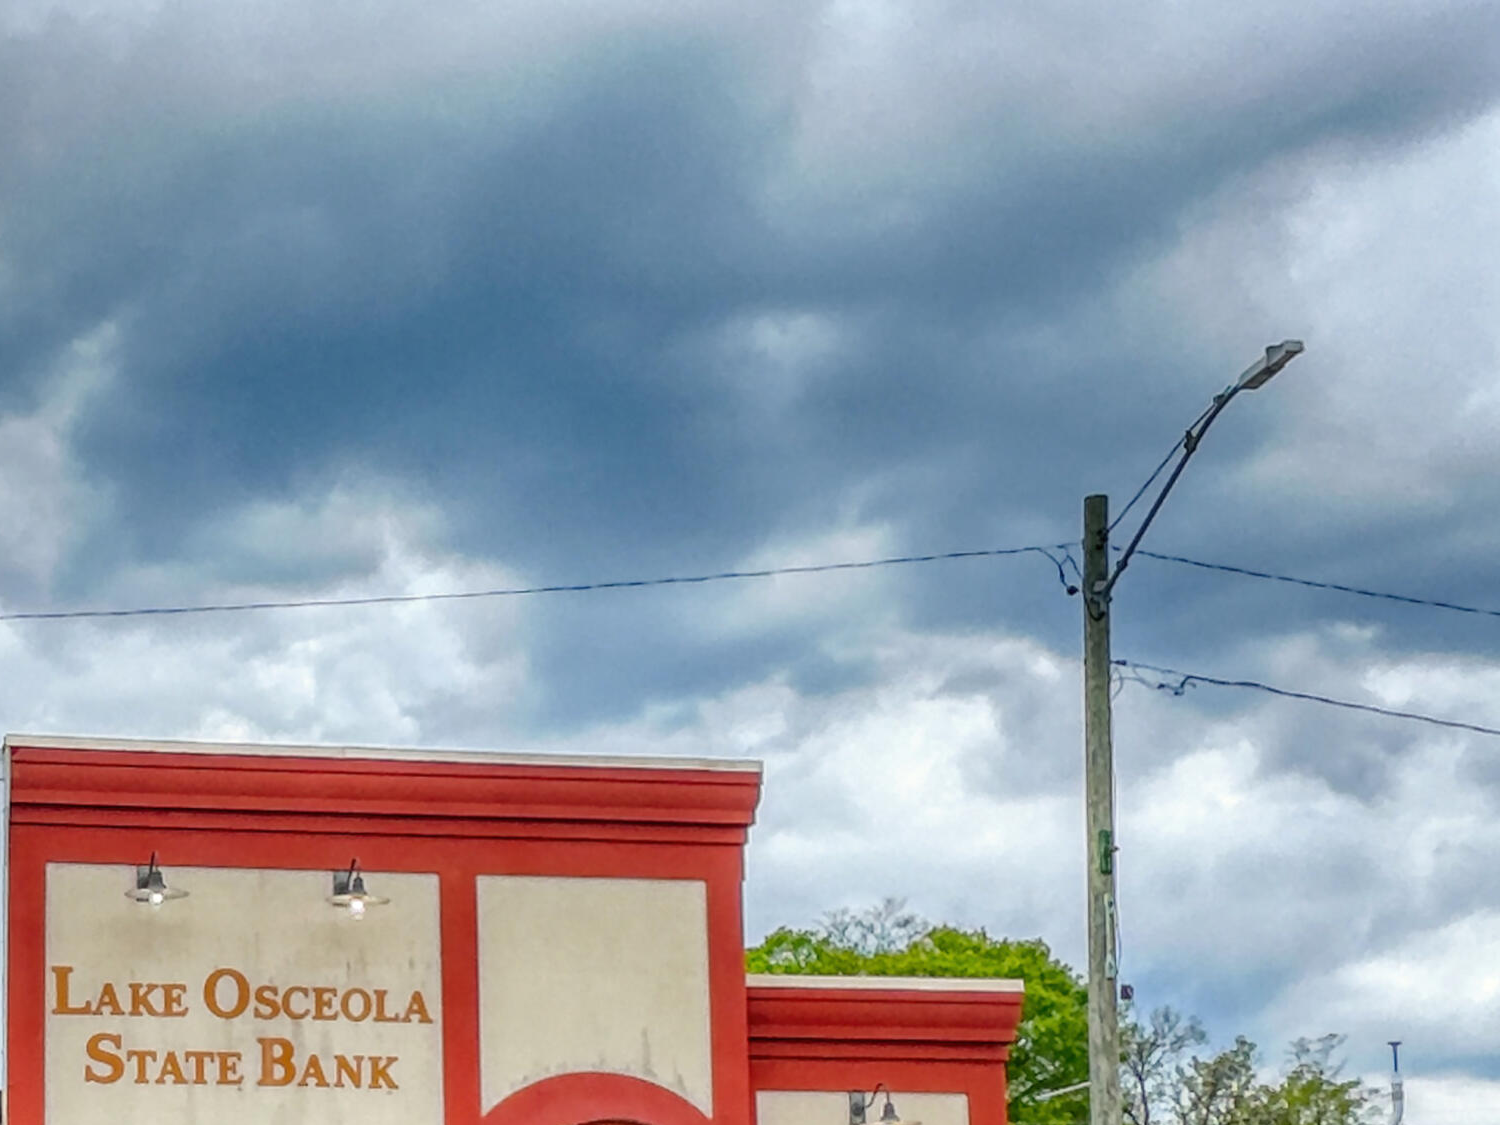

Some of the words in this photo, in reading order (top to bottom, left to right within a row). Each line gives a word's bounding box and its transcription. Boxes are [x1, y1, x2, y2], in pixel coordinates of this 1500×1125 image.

[51, 966, 190, 1018] LAKE
[203, 968, 433, 1024] OSCEOLA
[84, 1033, 244, 1085] STATE
[256, 1037, 399, 1089] BANK
